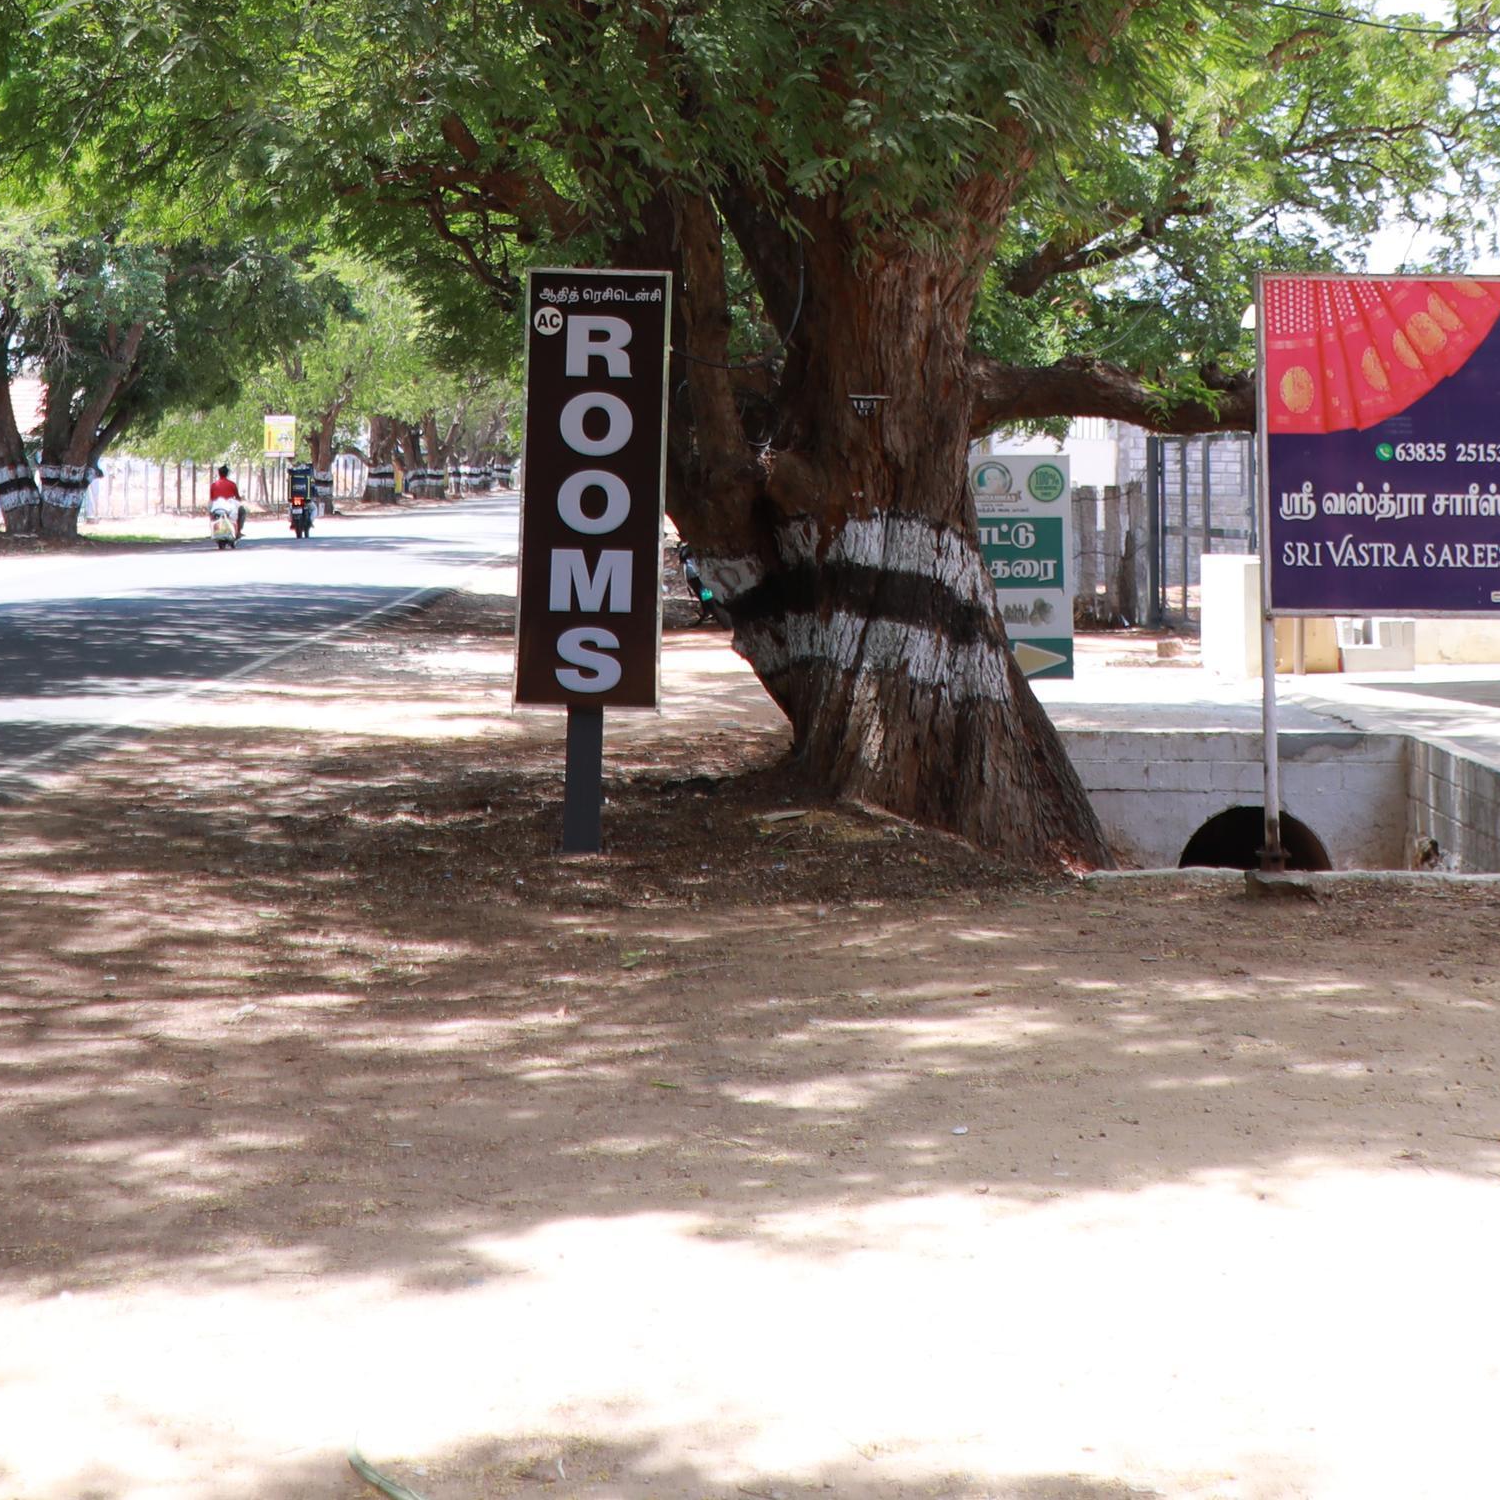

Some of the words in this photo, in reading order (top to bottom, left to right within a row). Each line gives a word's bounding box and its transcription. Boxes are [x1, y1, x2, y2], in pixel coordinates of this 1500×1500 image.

[539, 286, 580, 304] ஆதித்
[582, 287, 662, 304] ரெசிடென்சி
[537, 313, 561, 329] AC
[1394, 443, 1446, 462] 63835
[548, 314, 634, 693] ROOMS
[1322, 481, 1427, 522] வஸ்த்ரா
[1282, 541, 1323, 567] SRI
[1326, 533, 1419, 567] VASTRA
